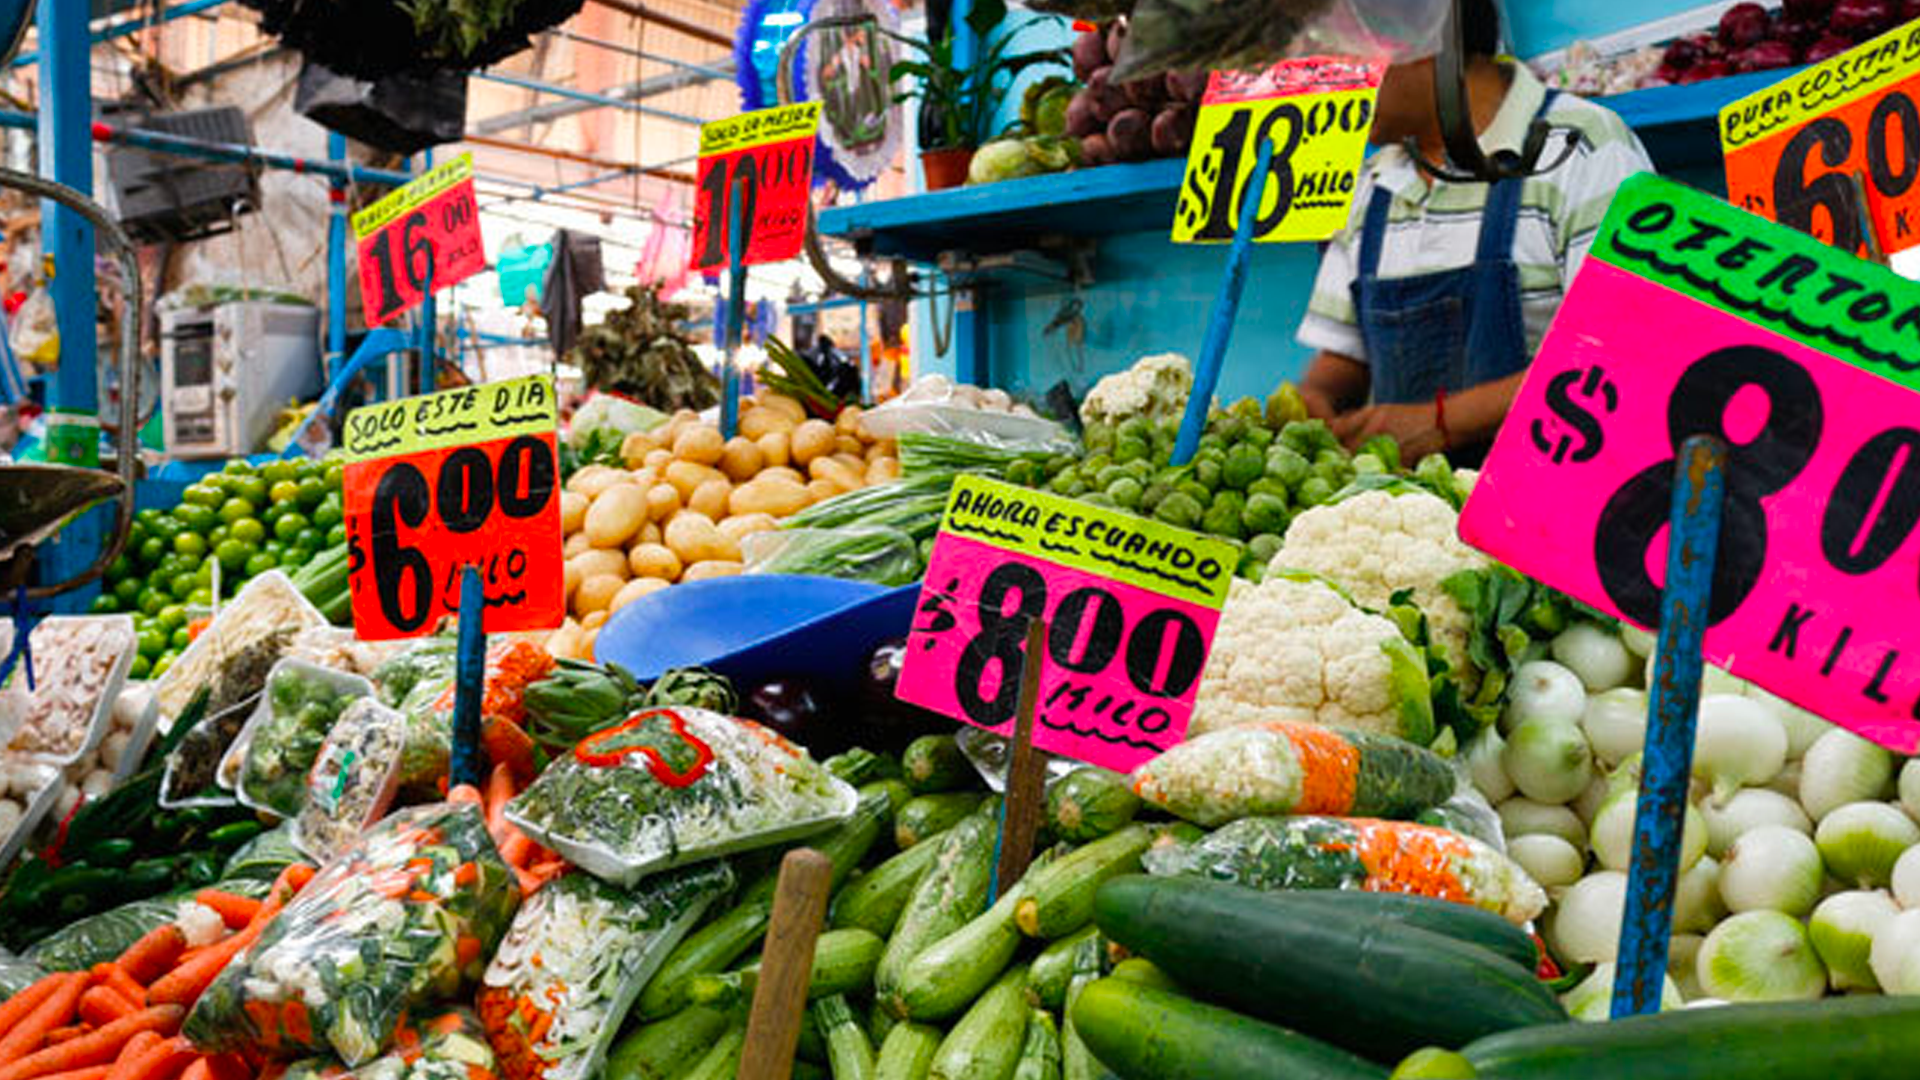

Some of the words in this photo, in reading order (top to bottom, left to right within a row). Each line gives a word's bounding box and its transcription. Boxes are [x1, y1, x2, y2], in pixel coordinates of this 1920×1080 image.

[1726, 91, 1792, 131] PURA
[350, 407, 406, 443] SOLO
[414, 387, 481, 424] ESTE
[493, 382, 545, 413] DIA
[951, 489, 1041, 528] AHORA
[1768, 603, 1920, 722] KIL
[1046, 682, 1171, 733] KILO
